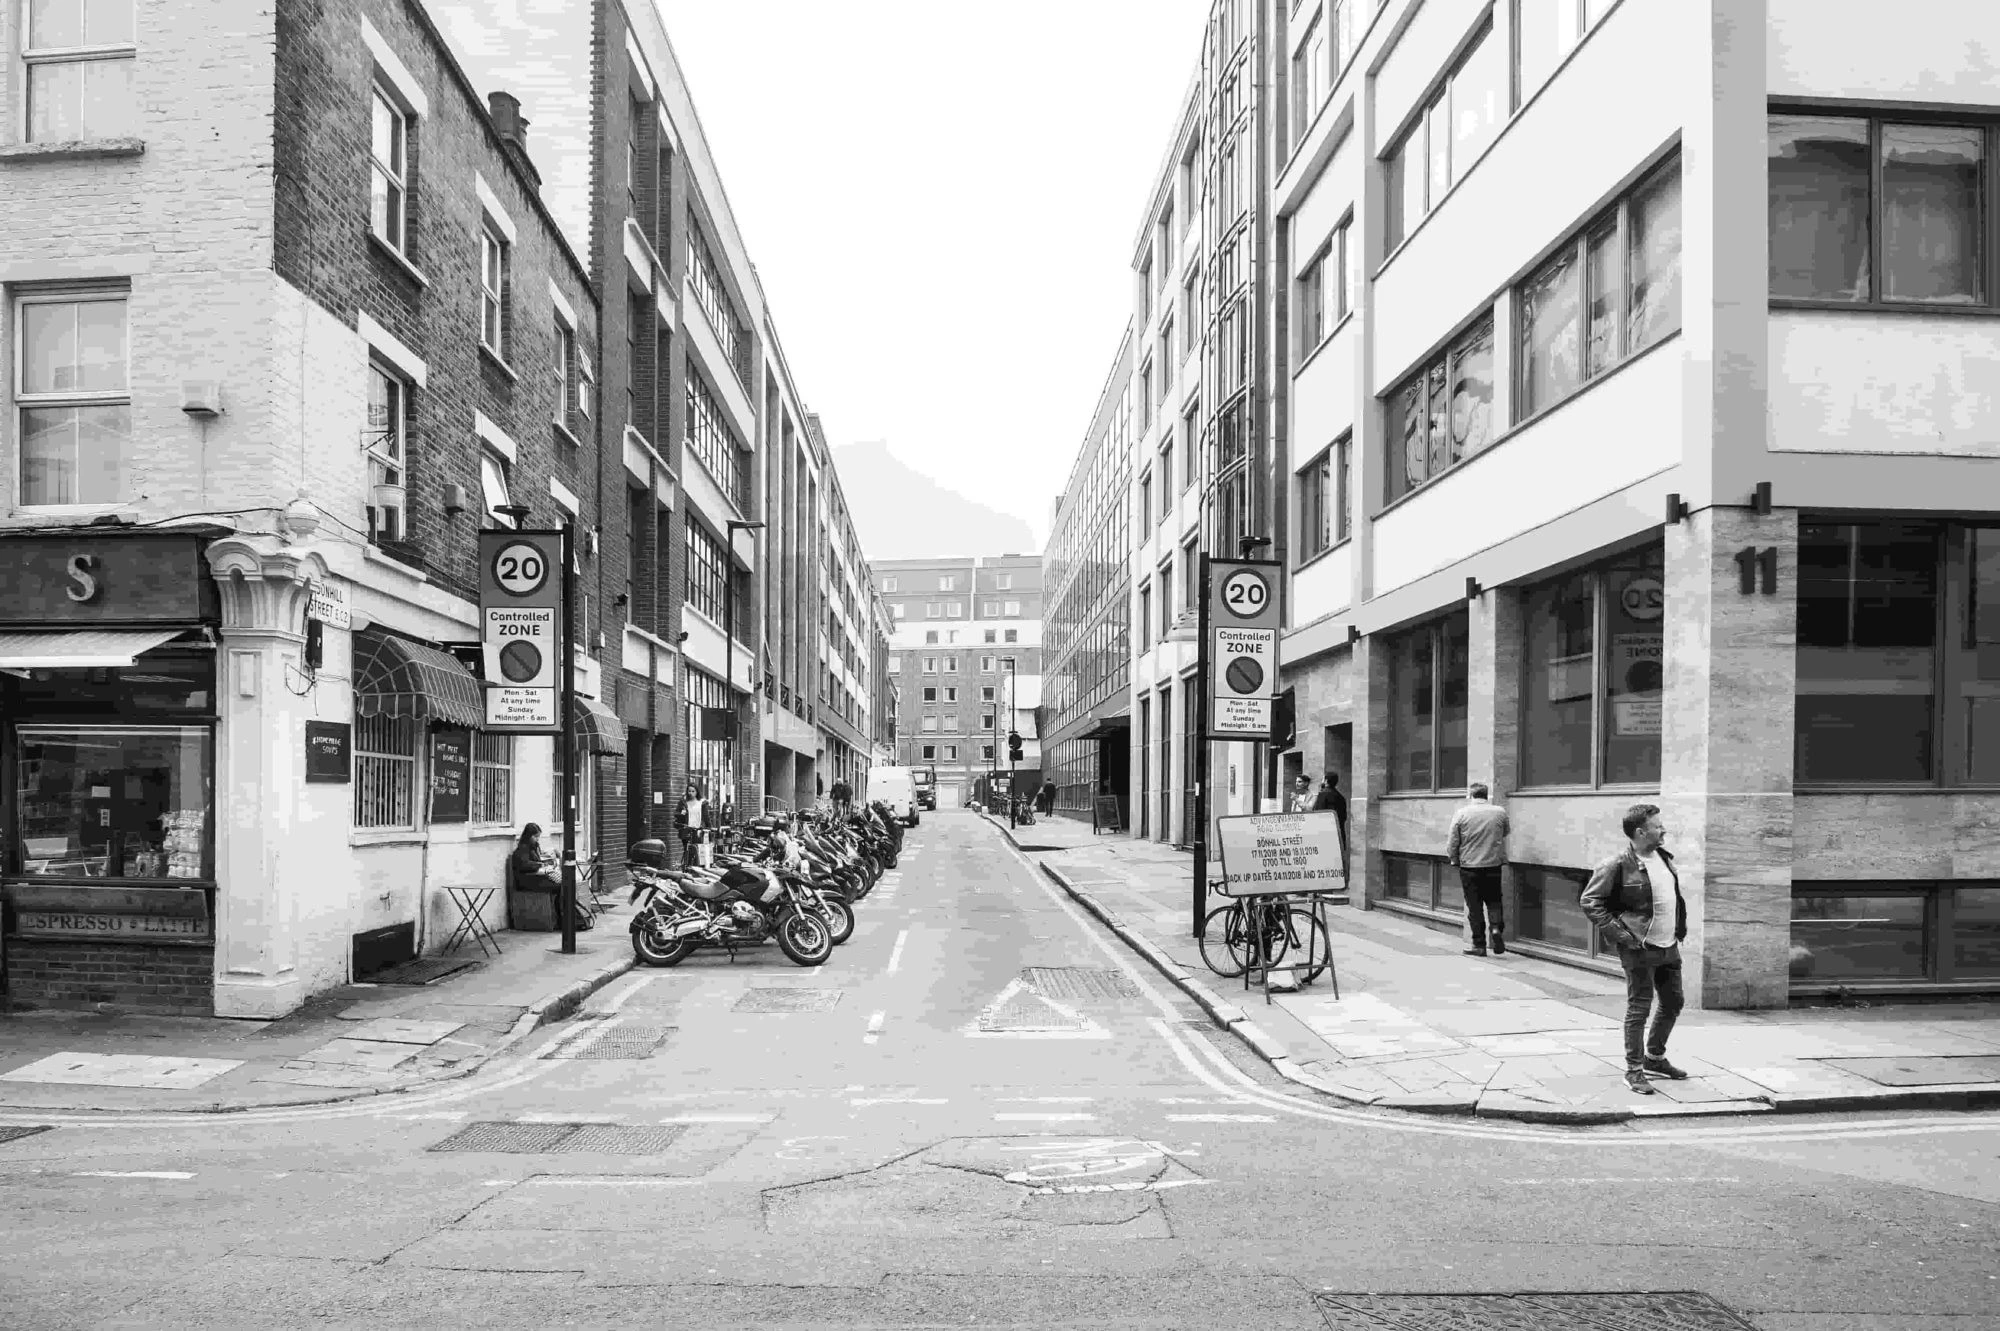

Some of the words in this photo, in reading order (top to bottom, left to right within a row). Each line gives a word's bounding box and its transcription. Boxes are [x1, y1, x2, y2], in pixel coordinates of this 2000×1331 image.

[500, 556, 541, 581] 20
[1734, 545, 1777, 595] 11
[66, 553, 95, 601] S
[1229, 583, 1265, 605] 20
[310, 599, 333, 617] STREET
[490, 611, 550, 622] Controlled
[499, 624, 541, 636] ZONE
[1219, 630, 1271, 642] Controlled
[1226, 642, 1264, 654] ZONE
[507, 706, 534, 714] Sunday
[494, 713, 525, 722] Midnight
[1232, 715, 1255, 723] Sunday
[1279, 848, 1291, 857] AND
[1262, 857, 1279, 867] 0700
[1279, 857, 1291, 866] TILL
[1243, 873, 1251, 882] UP
[1303, 870, 1316, 879] AND
[24, 914, 123, 931] ESPRESSO
[143, 917, 205, 933] LATTE
